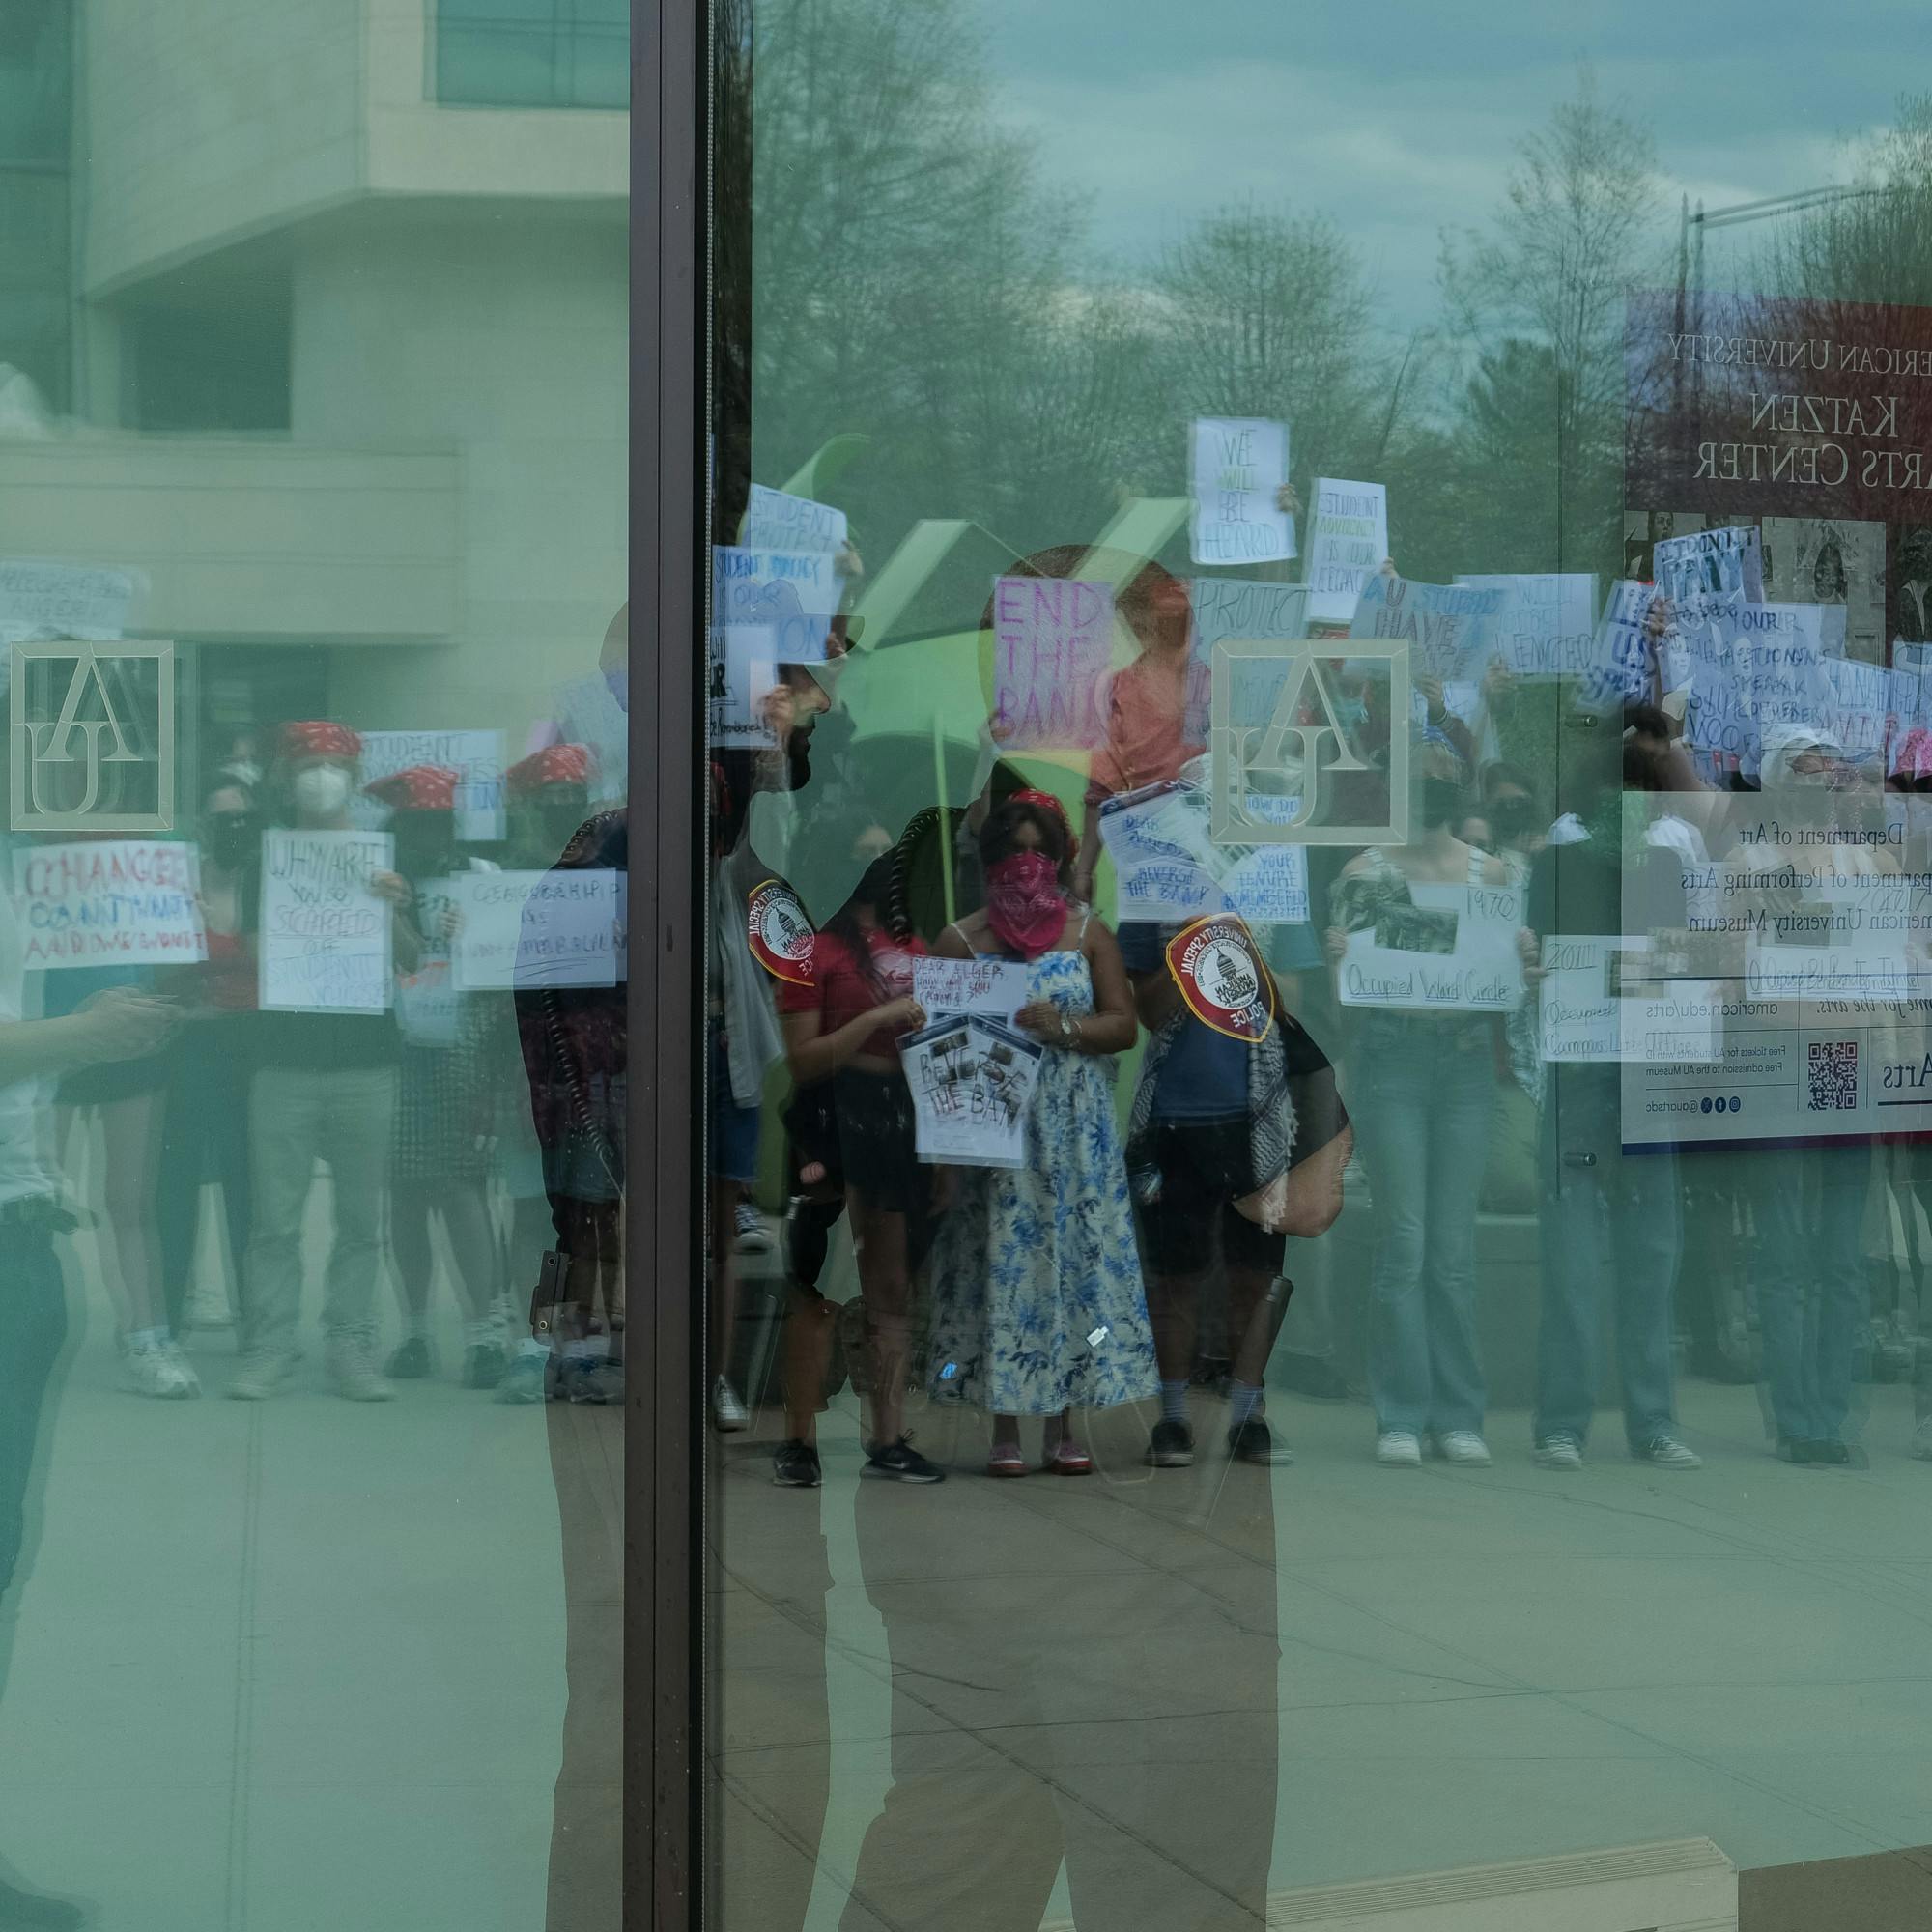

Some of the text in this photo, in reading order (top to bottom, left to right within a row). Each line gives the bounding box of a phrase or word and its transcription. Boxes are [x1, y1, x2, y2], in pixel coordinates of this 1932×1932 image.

[1312, 566, 1362, 594] LEGAC
[1000, 582, 1101, 628] END
[1001, 634, 1095, 680] THE
[1465, 888, 1516, 921] 1970
[1348, 963, 1413, 1001] Occupied
